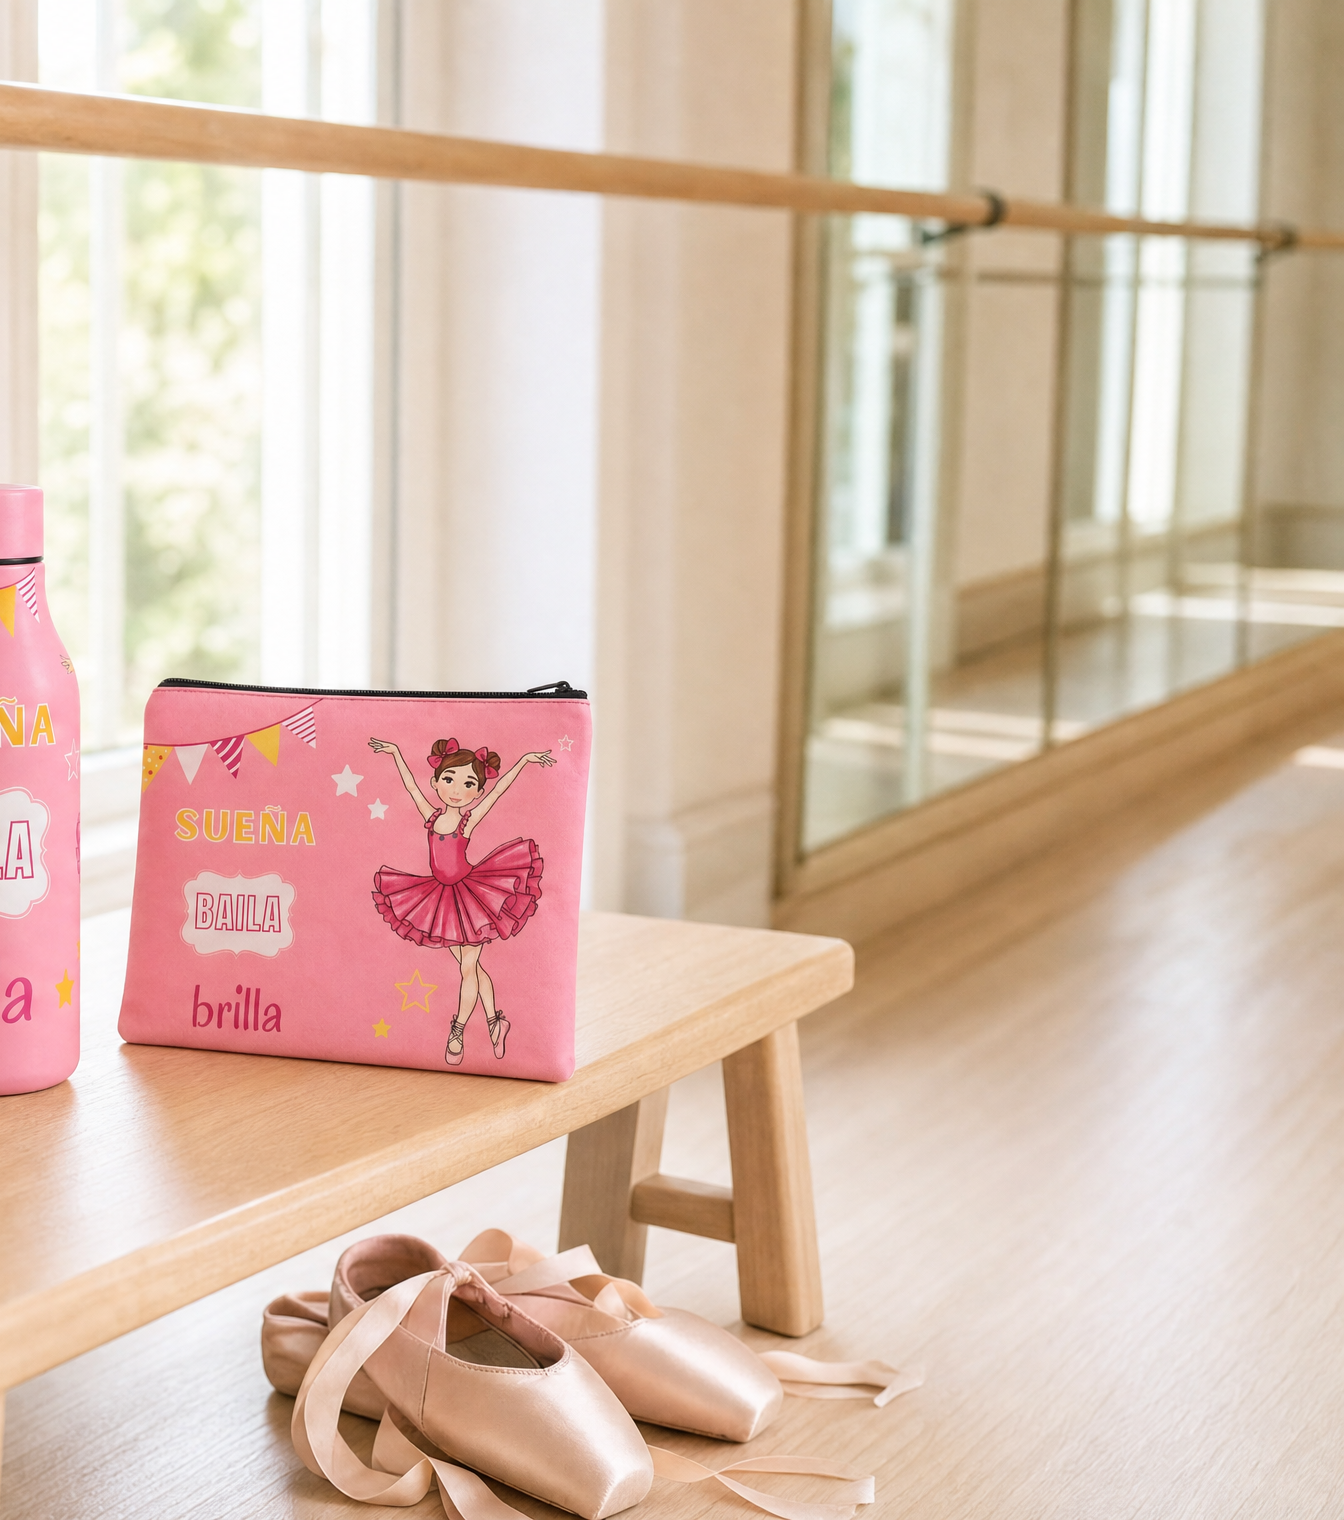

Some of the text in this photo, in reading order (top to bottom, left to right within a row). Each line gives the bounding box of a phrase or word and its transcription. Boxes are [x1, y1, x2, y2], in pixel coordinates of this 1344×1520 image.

[175, 805, 316, 845] SUEÑA
[195, 892, 282, 933] BAILA
[192, 984, 282, 1033] brilla
